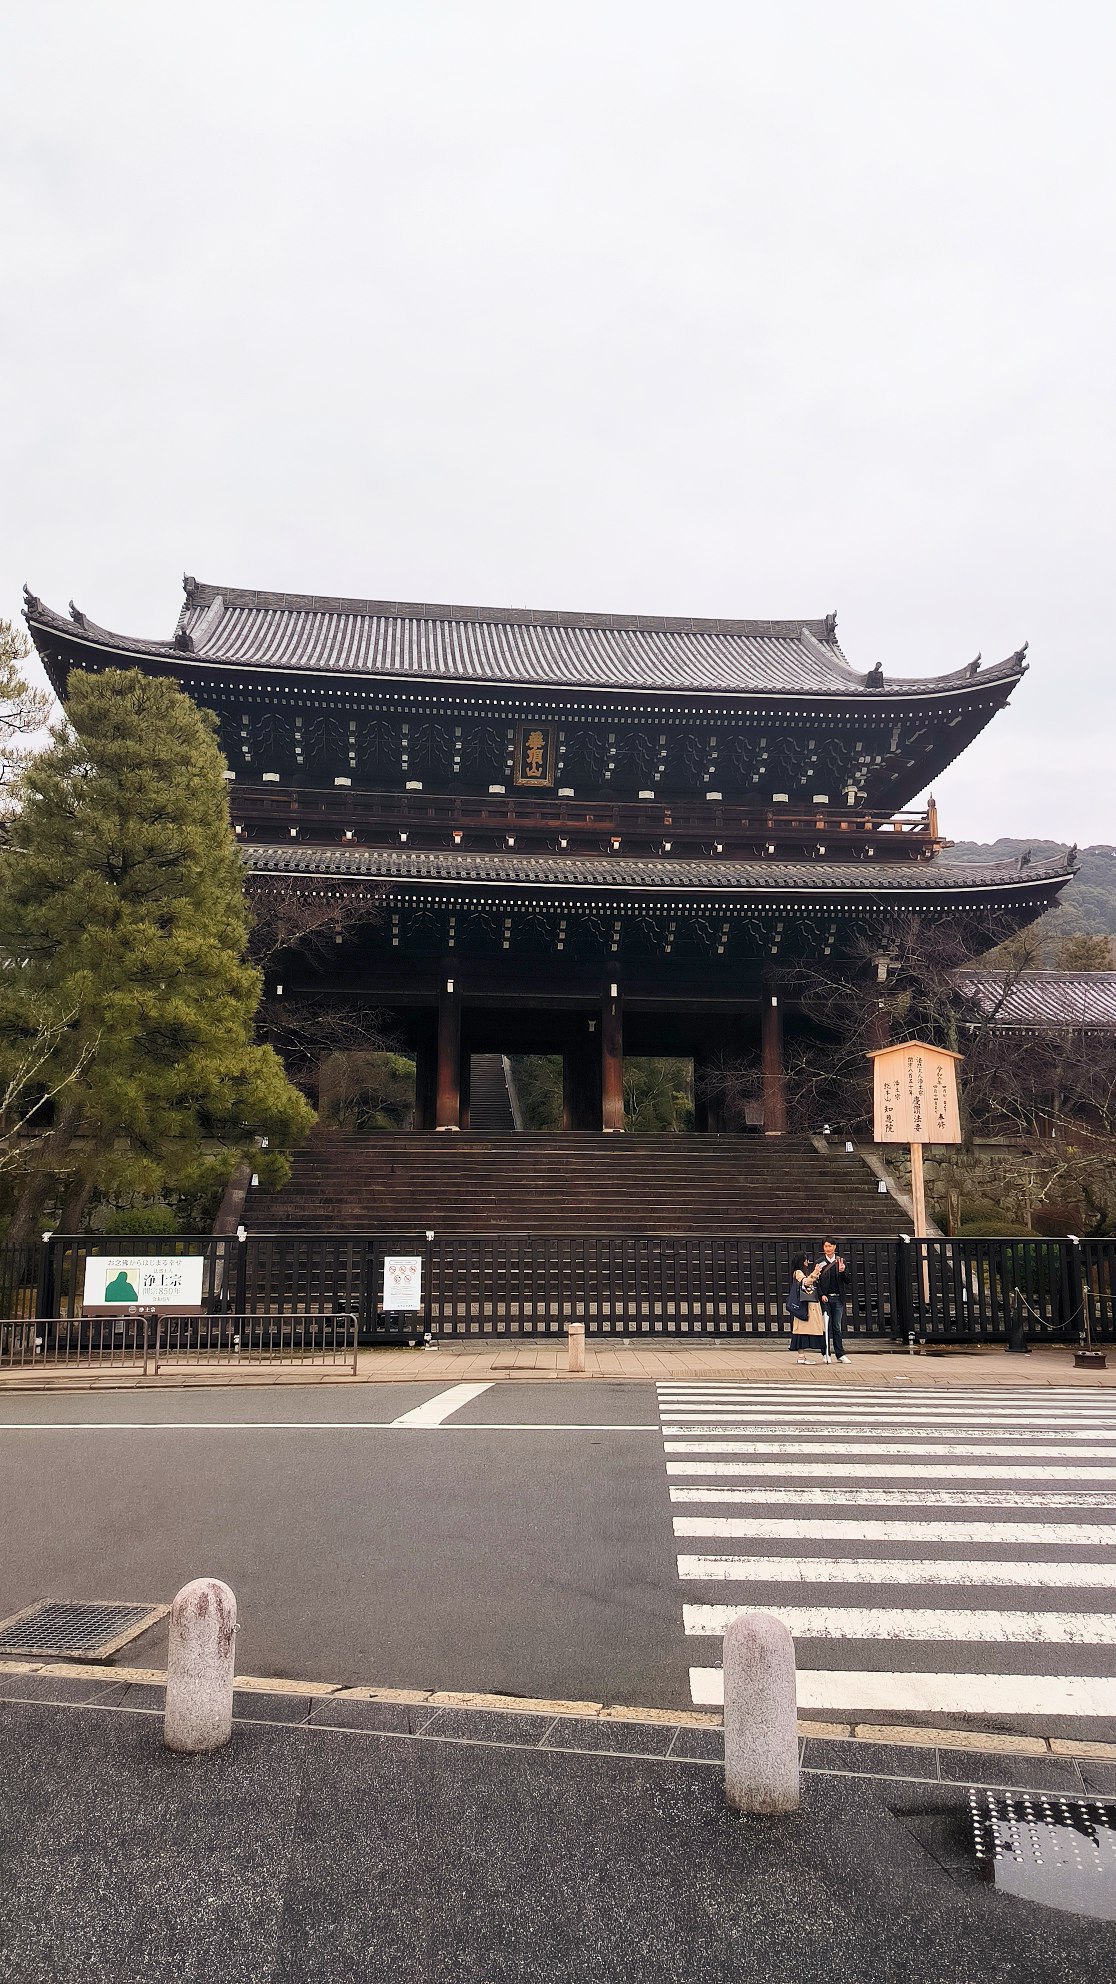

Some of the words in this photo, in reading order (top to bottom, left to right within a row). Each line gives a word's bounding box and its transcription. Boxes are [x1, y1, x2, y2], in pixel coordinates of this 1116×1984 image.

[525, 730, 546, 777] 華頂山
[143, 1274, 182, 1287] 浄土宗
